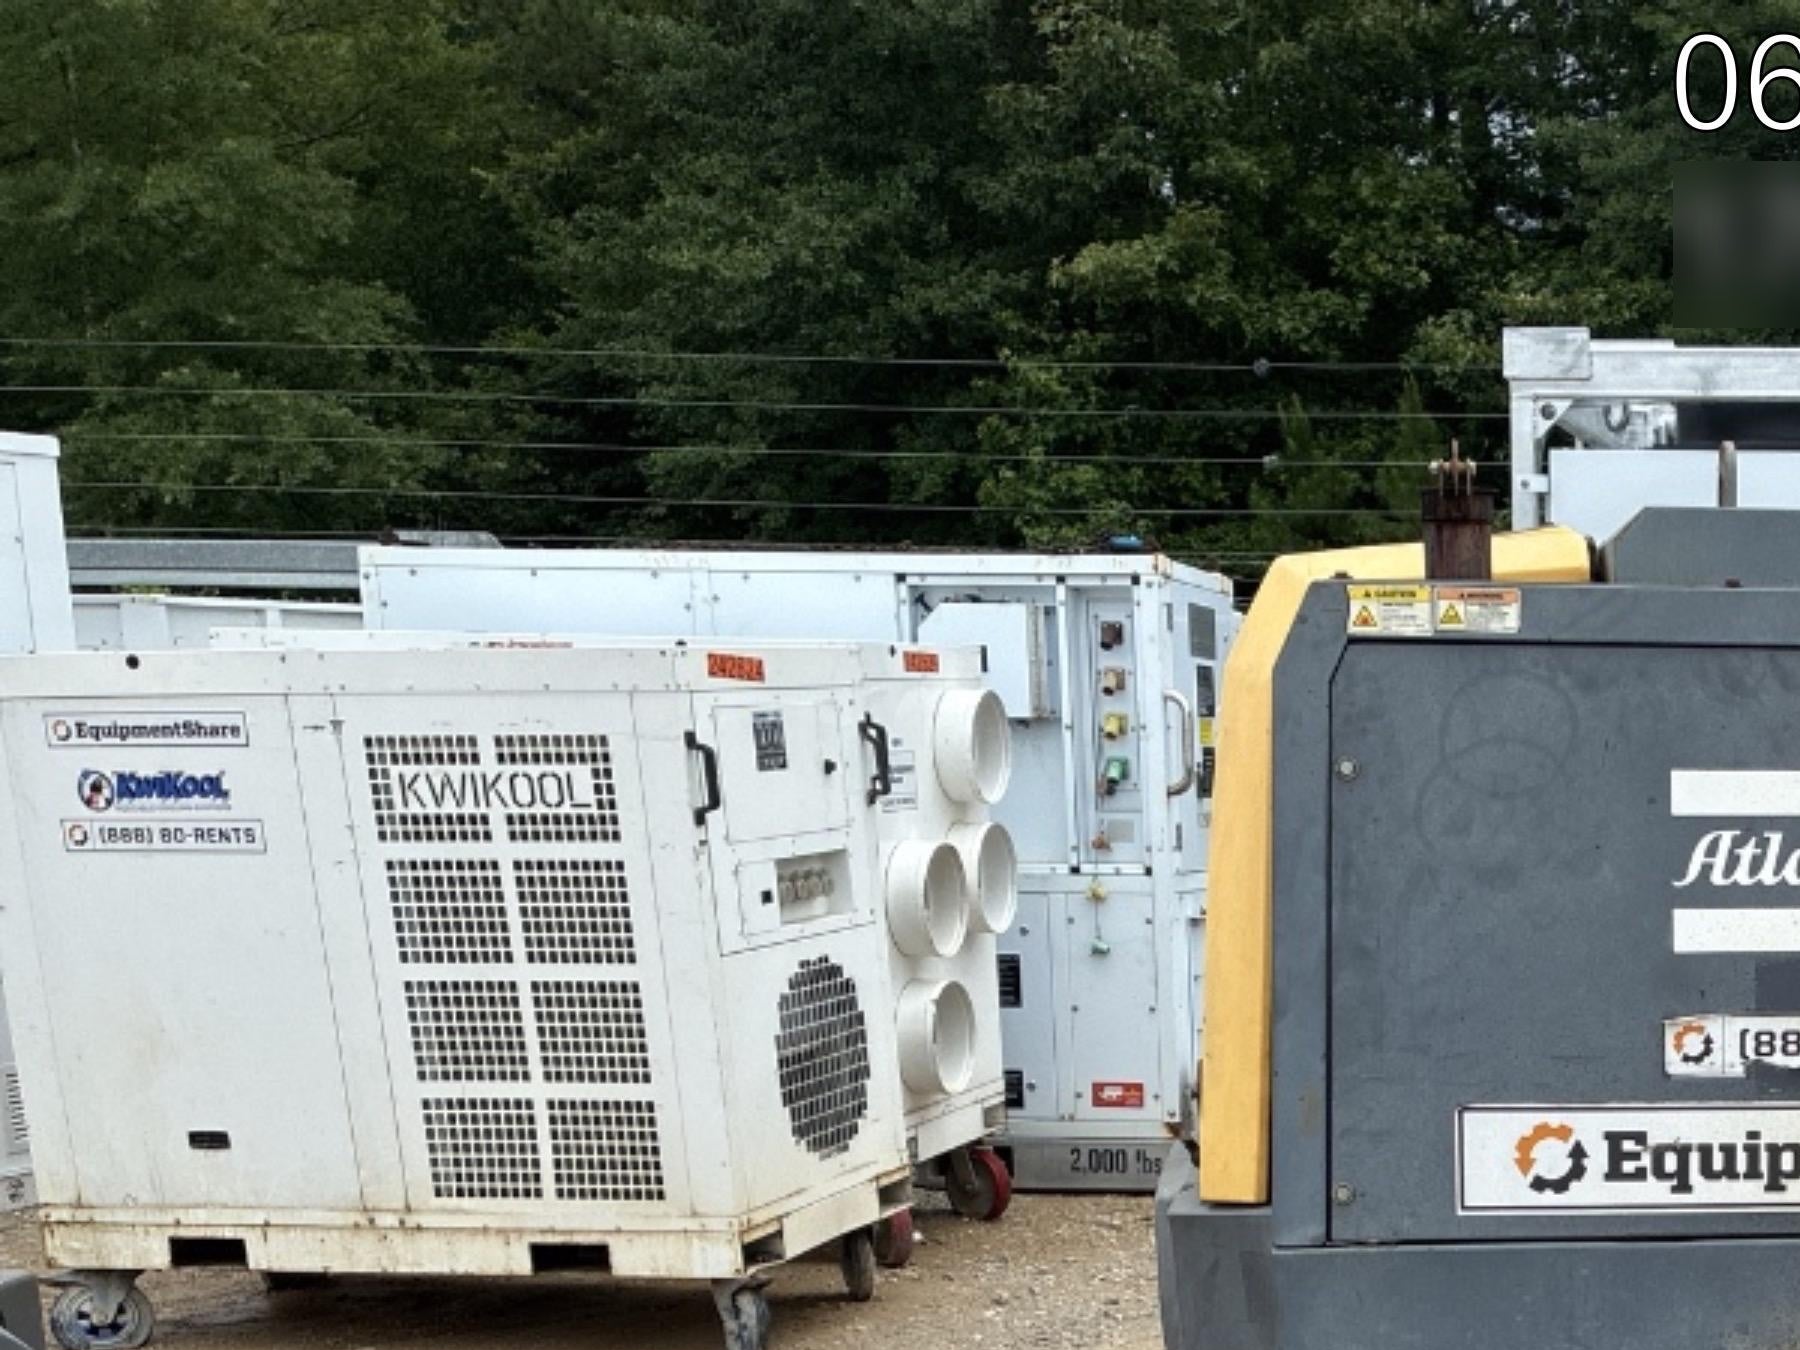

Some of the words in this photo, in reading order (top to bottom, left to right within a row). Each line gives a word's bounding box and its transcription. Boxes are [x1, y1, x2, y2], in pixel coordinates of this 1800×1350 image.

[74, 721, 241, 741] EquipmentShare
[398, 772, 592, 808] KWIKOOL
[159, 828, 256, 844] 80-RENTS
[1070, 1147, 1127, 1176] 2,000
